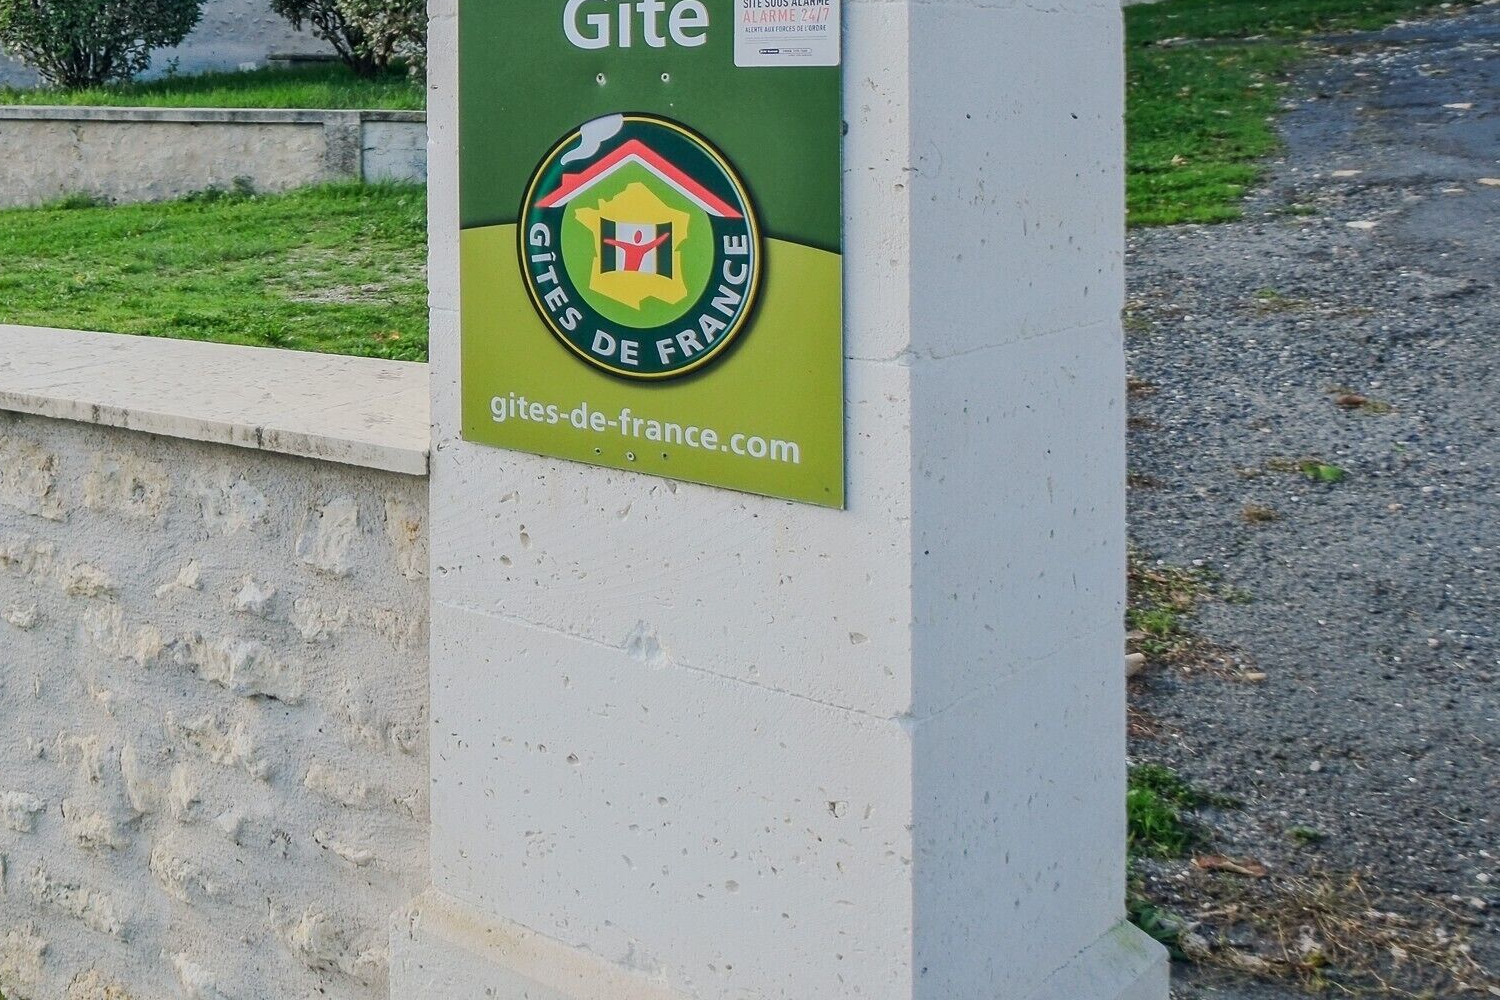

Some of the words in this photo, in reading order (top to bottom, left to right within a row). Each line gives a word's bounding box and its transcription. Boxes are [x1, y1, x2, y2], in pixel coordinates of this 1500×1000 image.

[742, 9, 796, 23] ALARME
[801, 7, 830, 23] 24/7
[804, 24, 827, 32] L'ORDRE
[529, 222, 583, 331] GÎTES
[591, 329, 639, 366] DE
[655, 233, 749, 365] FRANCE
[490, 391, 800, 464] gites-de-france.com
